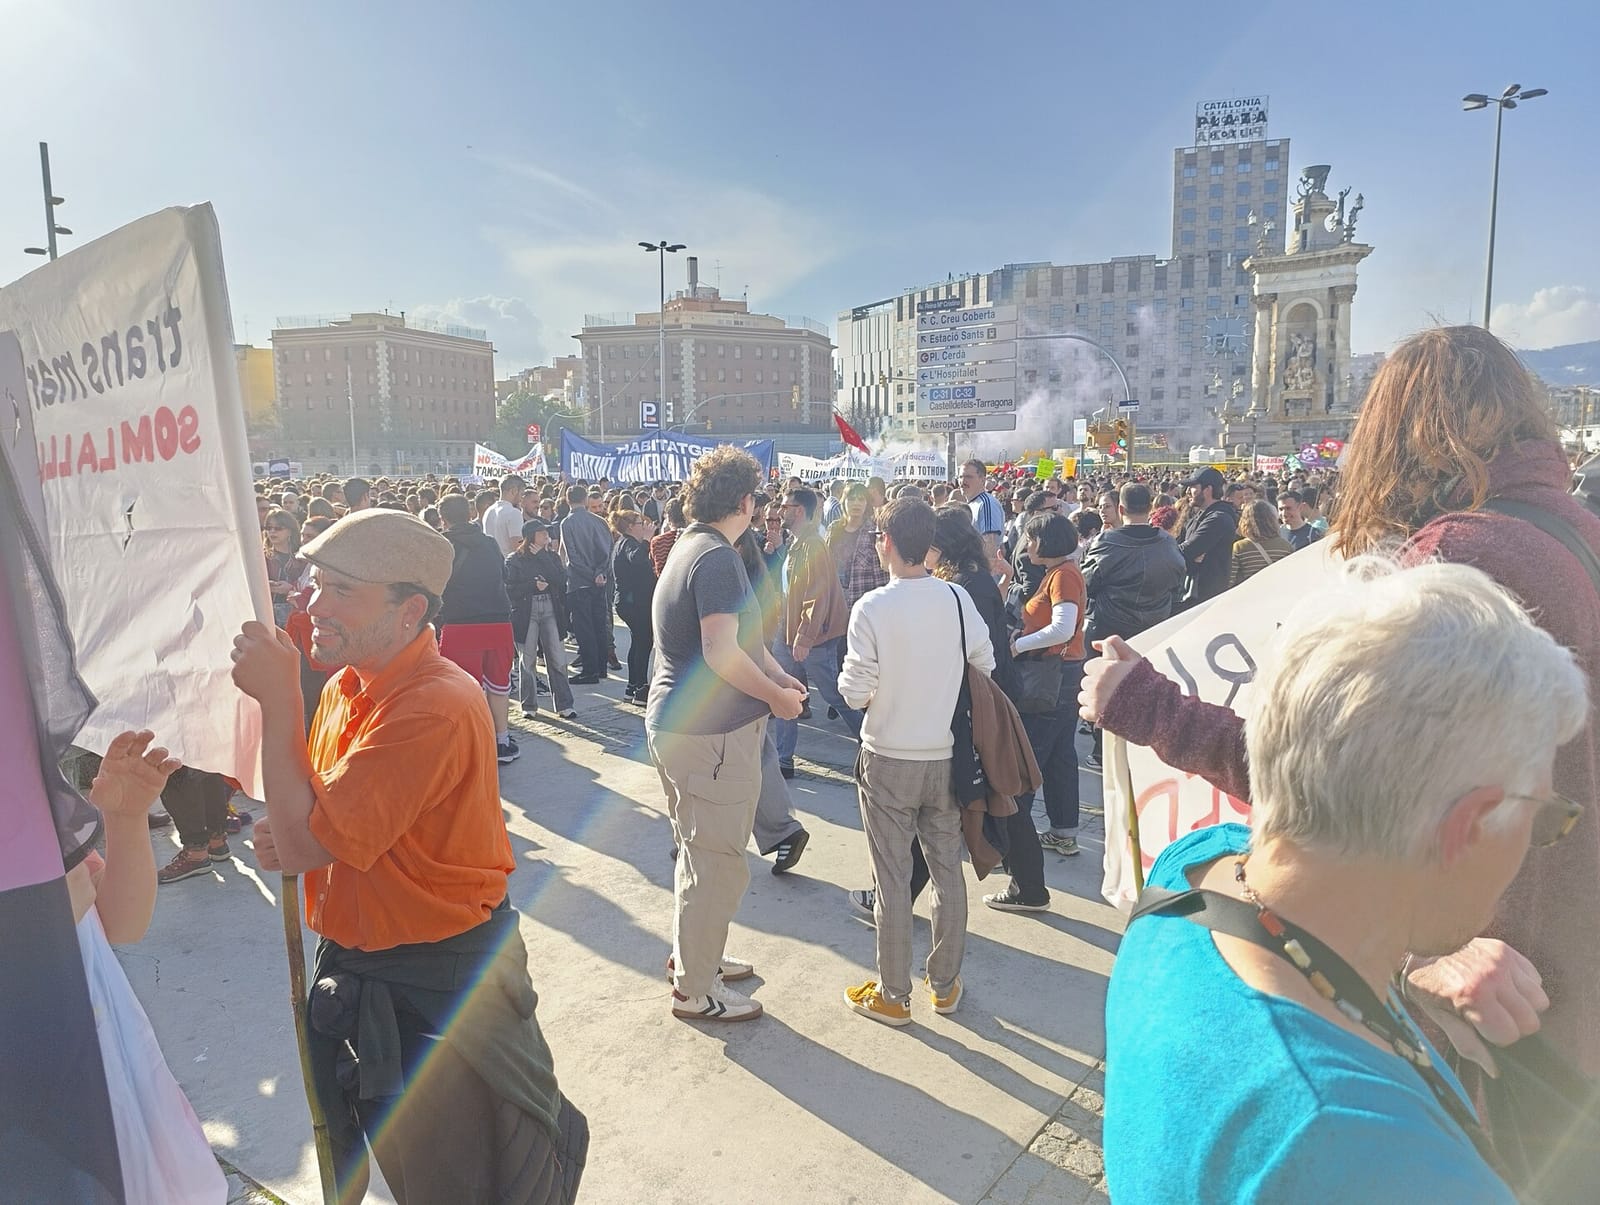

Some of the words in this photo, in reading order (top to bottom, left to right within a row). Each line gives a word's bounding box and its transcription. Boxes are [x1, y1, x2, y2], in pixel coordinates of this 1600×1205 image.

[1203, 98, 1261, 111] CATALONIA
[1196, 111, 1267, 129] PLAZA
[930, 316, 939, 326] C.
[941, 314, 960, 324] Creu
[962, 310, 996, 321] Coberta
[930, 331, 959, 344] Estació
[961, 329, 985, 340] Sants
[930, 352, 940, 361] Pl.
[942, 350, 966, 360] Cerdà
[930, 367, 978, 380] L'Hospitalet
[933, 389, 949, 399] C-31
[955, 388, 973, 398] C-32
[929, 398, 1013, 411] Castelldefels-Tarragona
[643, 402, 656, 422] P
[617, 454, 683, 483] UNIVERSAL
[909, 465, 915, 476] A
[918, 465, 946, 476] TOTHOM
